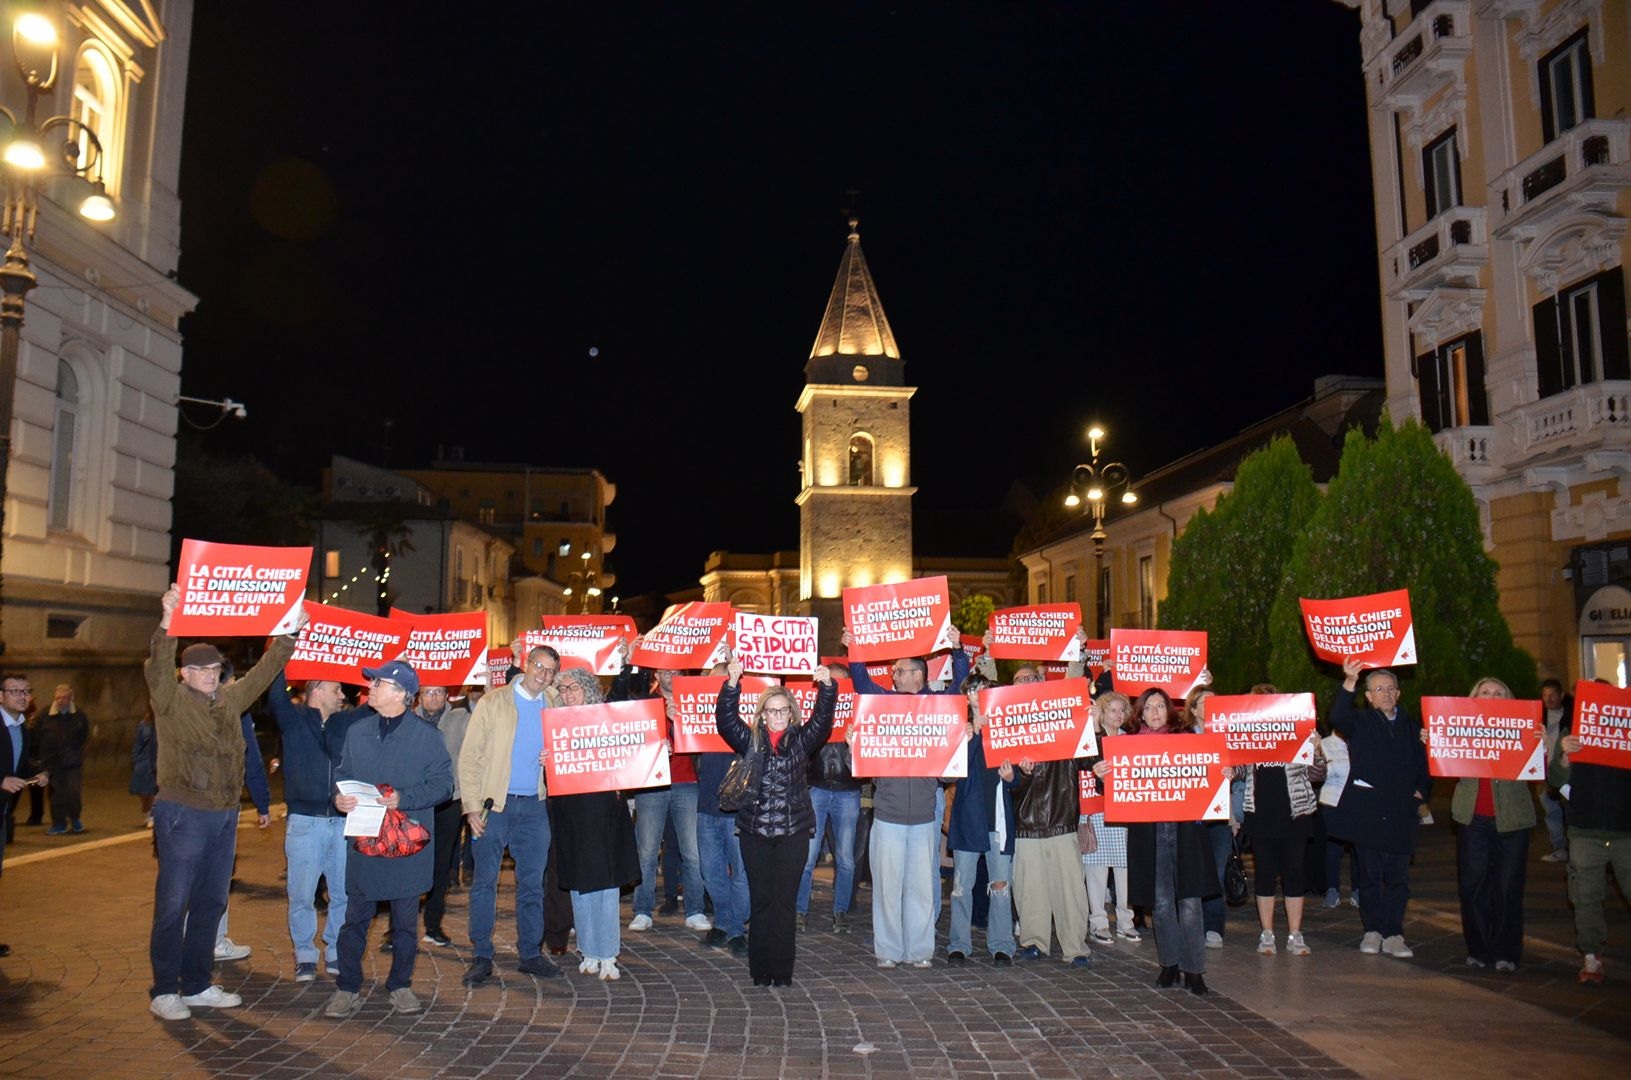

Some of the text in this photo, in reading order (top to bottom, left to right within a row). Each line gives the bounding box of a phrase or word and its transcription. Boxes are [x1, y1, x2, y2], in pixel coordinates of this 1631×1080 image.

[189, 564, 302, 580] LA CITTÁ CHIEDE
[187, 578, 286, 592] LE DIMISSIONI
[185, 591, 285, 604] DELLA GIUNTA
[182, 604, 260, 616] MASTELLA!
[850, 595, 941, 615] LA CITTÁ CHIEDE
[687, 617, 723, 627] CHIEDE
[852, 607, 931, 625] LE DIMISSIONI
[1009, 611, 1038, 619] CITTÁ
[1040, 612, 1075, 620] CHIEDE
[1308, 608, 1402, 626] LA CITTÁ CHIEDE
[740, 616, 766, 633] LA
[771, 618, 814, 635] CITTÀ
[853, 618, 934, 635] DELLA GIUNTA
[1009, 618, 1065, 628] DIMISSIONI
[1311, 621, 1391, 635] LE DIMISSIONI
[314, 623, 351, 637] CITTÁ
[354, 630, 401, 644] CHIEDE
[410, 629, 482, 640] CITTÁ CHIEDE
[541, 629, 605, 638] DIMISSIONI
[658, 625, 711, 636] DIMISSIONI
[996, 626, 1066, 637] DELLA GIUNTA
[309, 633, 384, 651] DIMISSIONI
[526, 635, 560, 645] DELLA
[672, 635, 711, 645] GIUNTA
[738, 633, 816, 654] SFIDUCIA
[855, 630, 915, 646] MASTELLA!
[995, 635, 1048, 645] MASTELLA!
[1313, 630, 1395, 645] DELLA GIUNTA
[332, 645, 383, 659] GIUNTA
[407, 640, 470, 651] DIMISSIONI
[640, 642, 694, 654] MASTELLA!
[1117, 643, 1201, 657] LA CITTÁ CHIEDE
[1316, 641, 1375, 655] MASTELLA!
[429, 650, 471, 660] GIUNTA
[737, 652, 811, 670] MASTELLA
[1116, 654, 1190, 665] LE DIMISSIONI
[408, 660, 452, 670] STELLA!
[1116, 663, 1191, 675] DELLA GIUNTA
[1117, 672, 1172, 683] MASTELLA!
[680, 693, 695, 703] LA
[681, 704, 694, 713] LE
[988, 696, 1083, 717] LA CITTÁ CHIEDE
[1581, 701, 1631, 718] LA CITT
[682, 714, 717, 724] DELLA
[861, 712, 959, 724] LA CITTÁ CHIEDE
[989, 709, 1072, 729] LE DIMISSIONI
[1212, 713, 1227, 722] LA
[1429, 714, 1534, 729] LA CITTÁ CHIEDE
[1580, 713, 1596, 724] LE
[551, 719, 658, 740] LA CITTÁ CHIEDE
[861, 725, 946, 736] LE DIMISSIONI
[990, 719, 1075, 739] DELLA GIUNTA
[1212, 722, 1295, 732] LE DIMISSIONI
[1429, 726, 1520, 739] LE DIMISSIONI
[1580, 724, 1624, 739] DELLA
[552, 732, 645, 752] LE DIMISSIONI
[861, 736, 949, 747] DELLA GIUNTA
[991, 734, 1056, 750] MASTELLA!
[1251, 732, 1297, 742] GIUNTA
[1579, 735, 1631, 751] MASTEL
[1226, 742, 1277, 750] ASTELLA!
[1430, 737, 1524, 751] DELLA GIUNTA
[554, 745, 647, 764] DELLA GIUNTA
[861, 747, 927, 758] MASTELLA!
[1430, 748, 1500, 761] MASTELLA!
[1112, 752, 1220, 767] LA CITTÁ CHIEDE
[555, 759, 627, 776] MASTELLA!
[1113, 766, 1207, 779] LE DIMISSIONI
[1081, 770, 1092, 779] LE
[1113, 777, 1209, 791] DELLA GIUNTA
[1113, 790, 1186, 803] MASTELLA!
